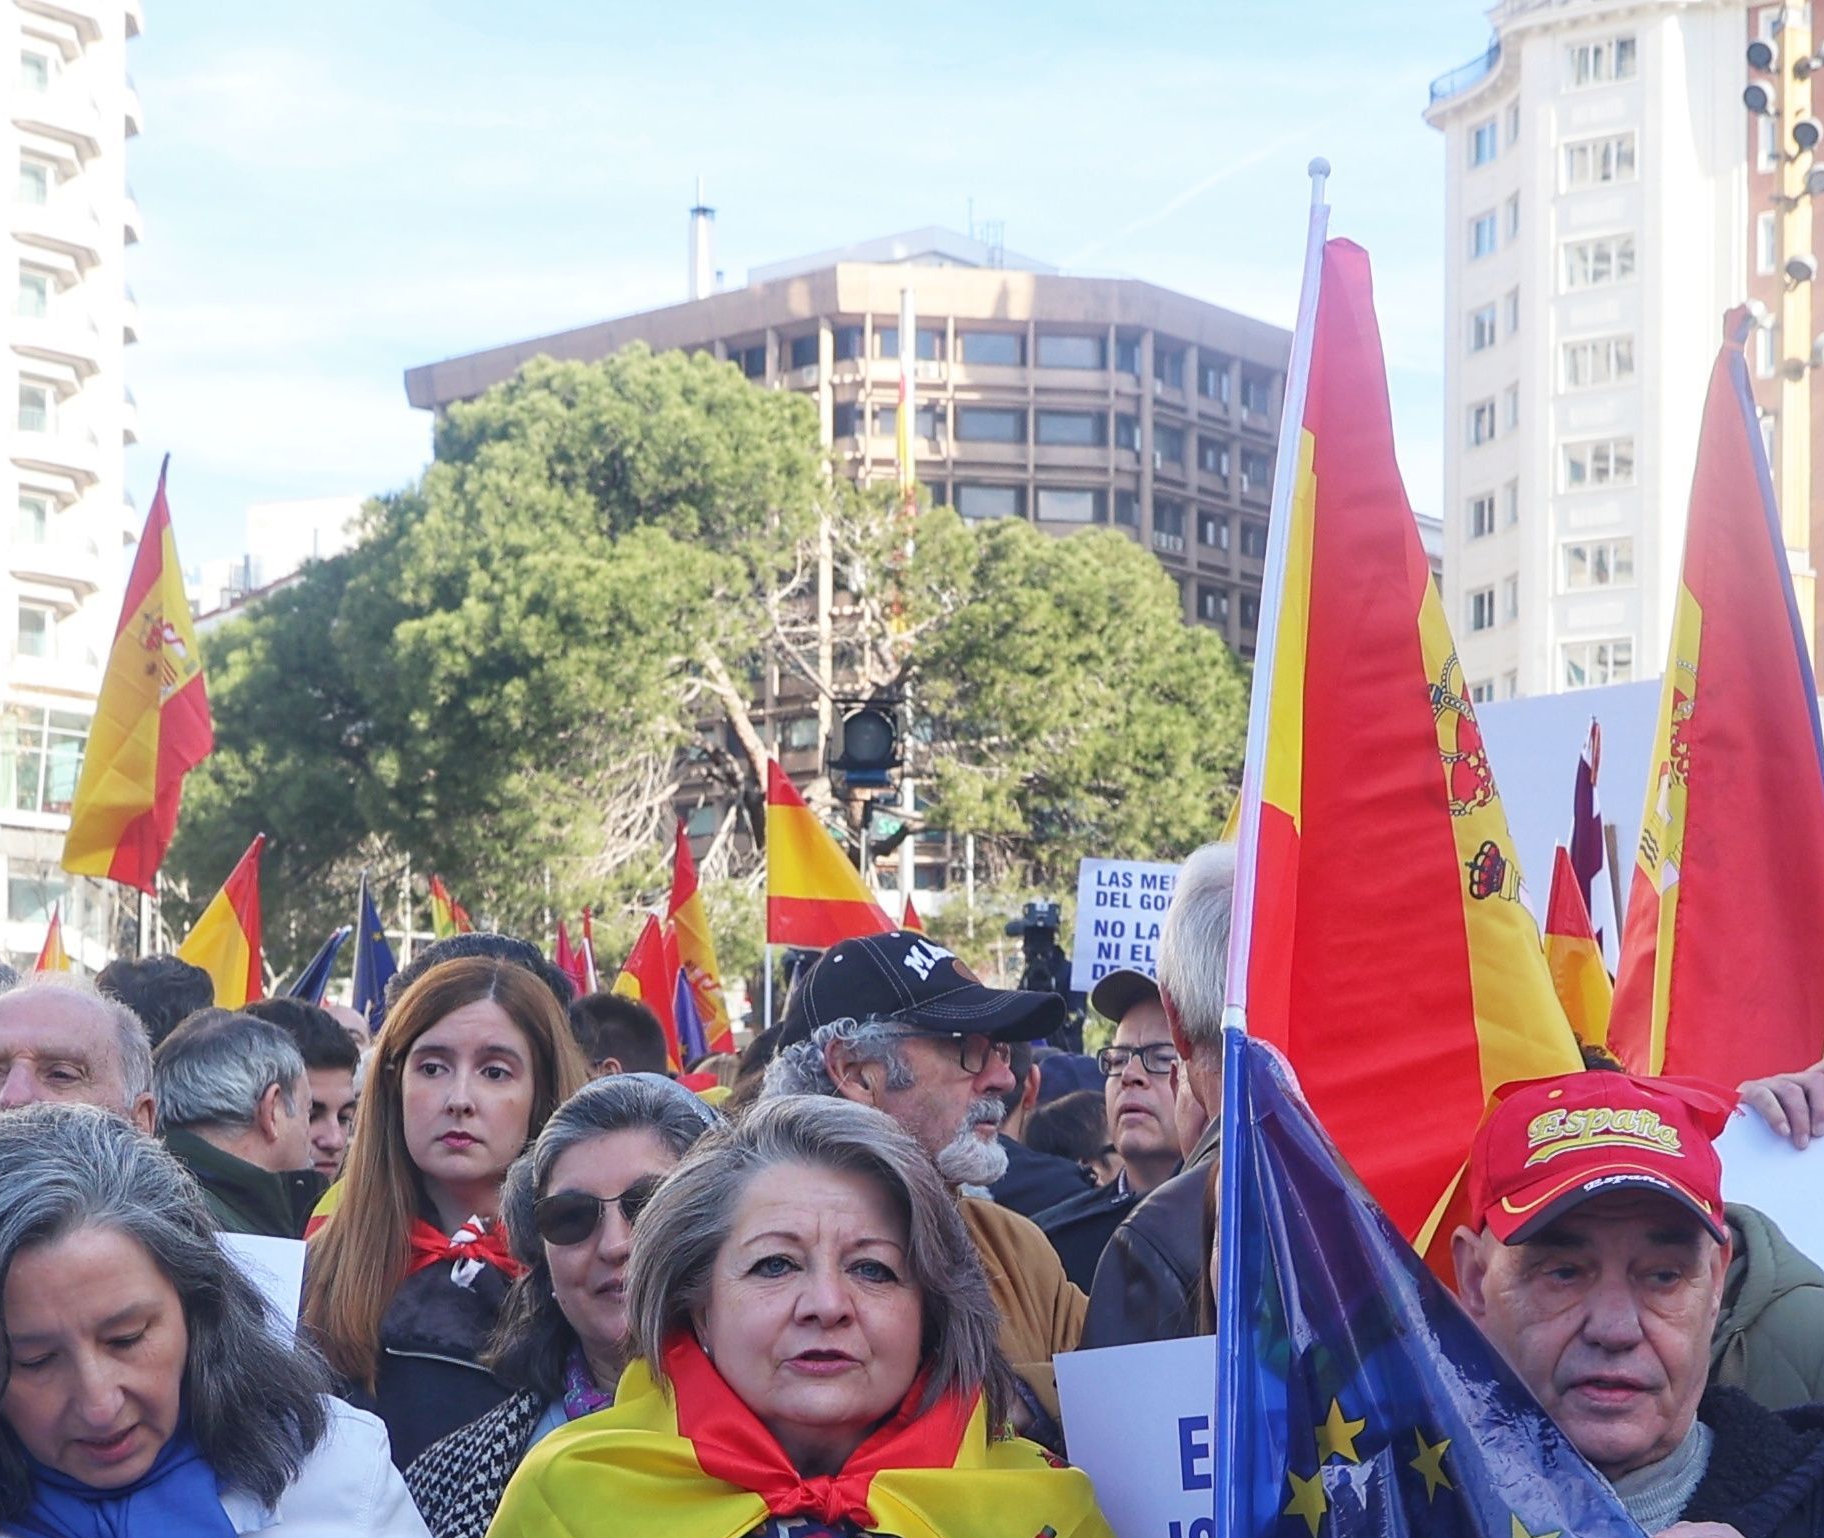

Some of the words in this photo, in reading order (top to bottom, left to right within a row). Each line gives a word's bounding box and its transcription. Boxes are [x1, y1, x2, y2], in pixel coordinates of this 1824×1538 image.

[1096, 870, 1132, 888] LAS
[1141, 873, 1176, 891] ME
[1095, 891, 1132, 909] DEL
[1140, 894, 1172, 911] GO
[1094, 919, 1125, 938] NO
[1097, 942, 1121, 960] NI
[1130, 944, 1156, 962] EL
